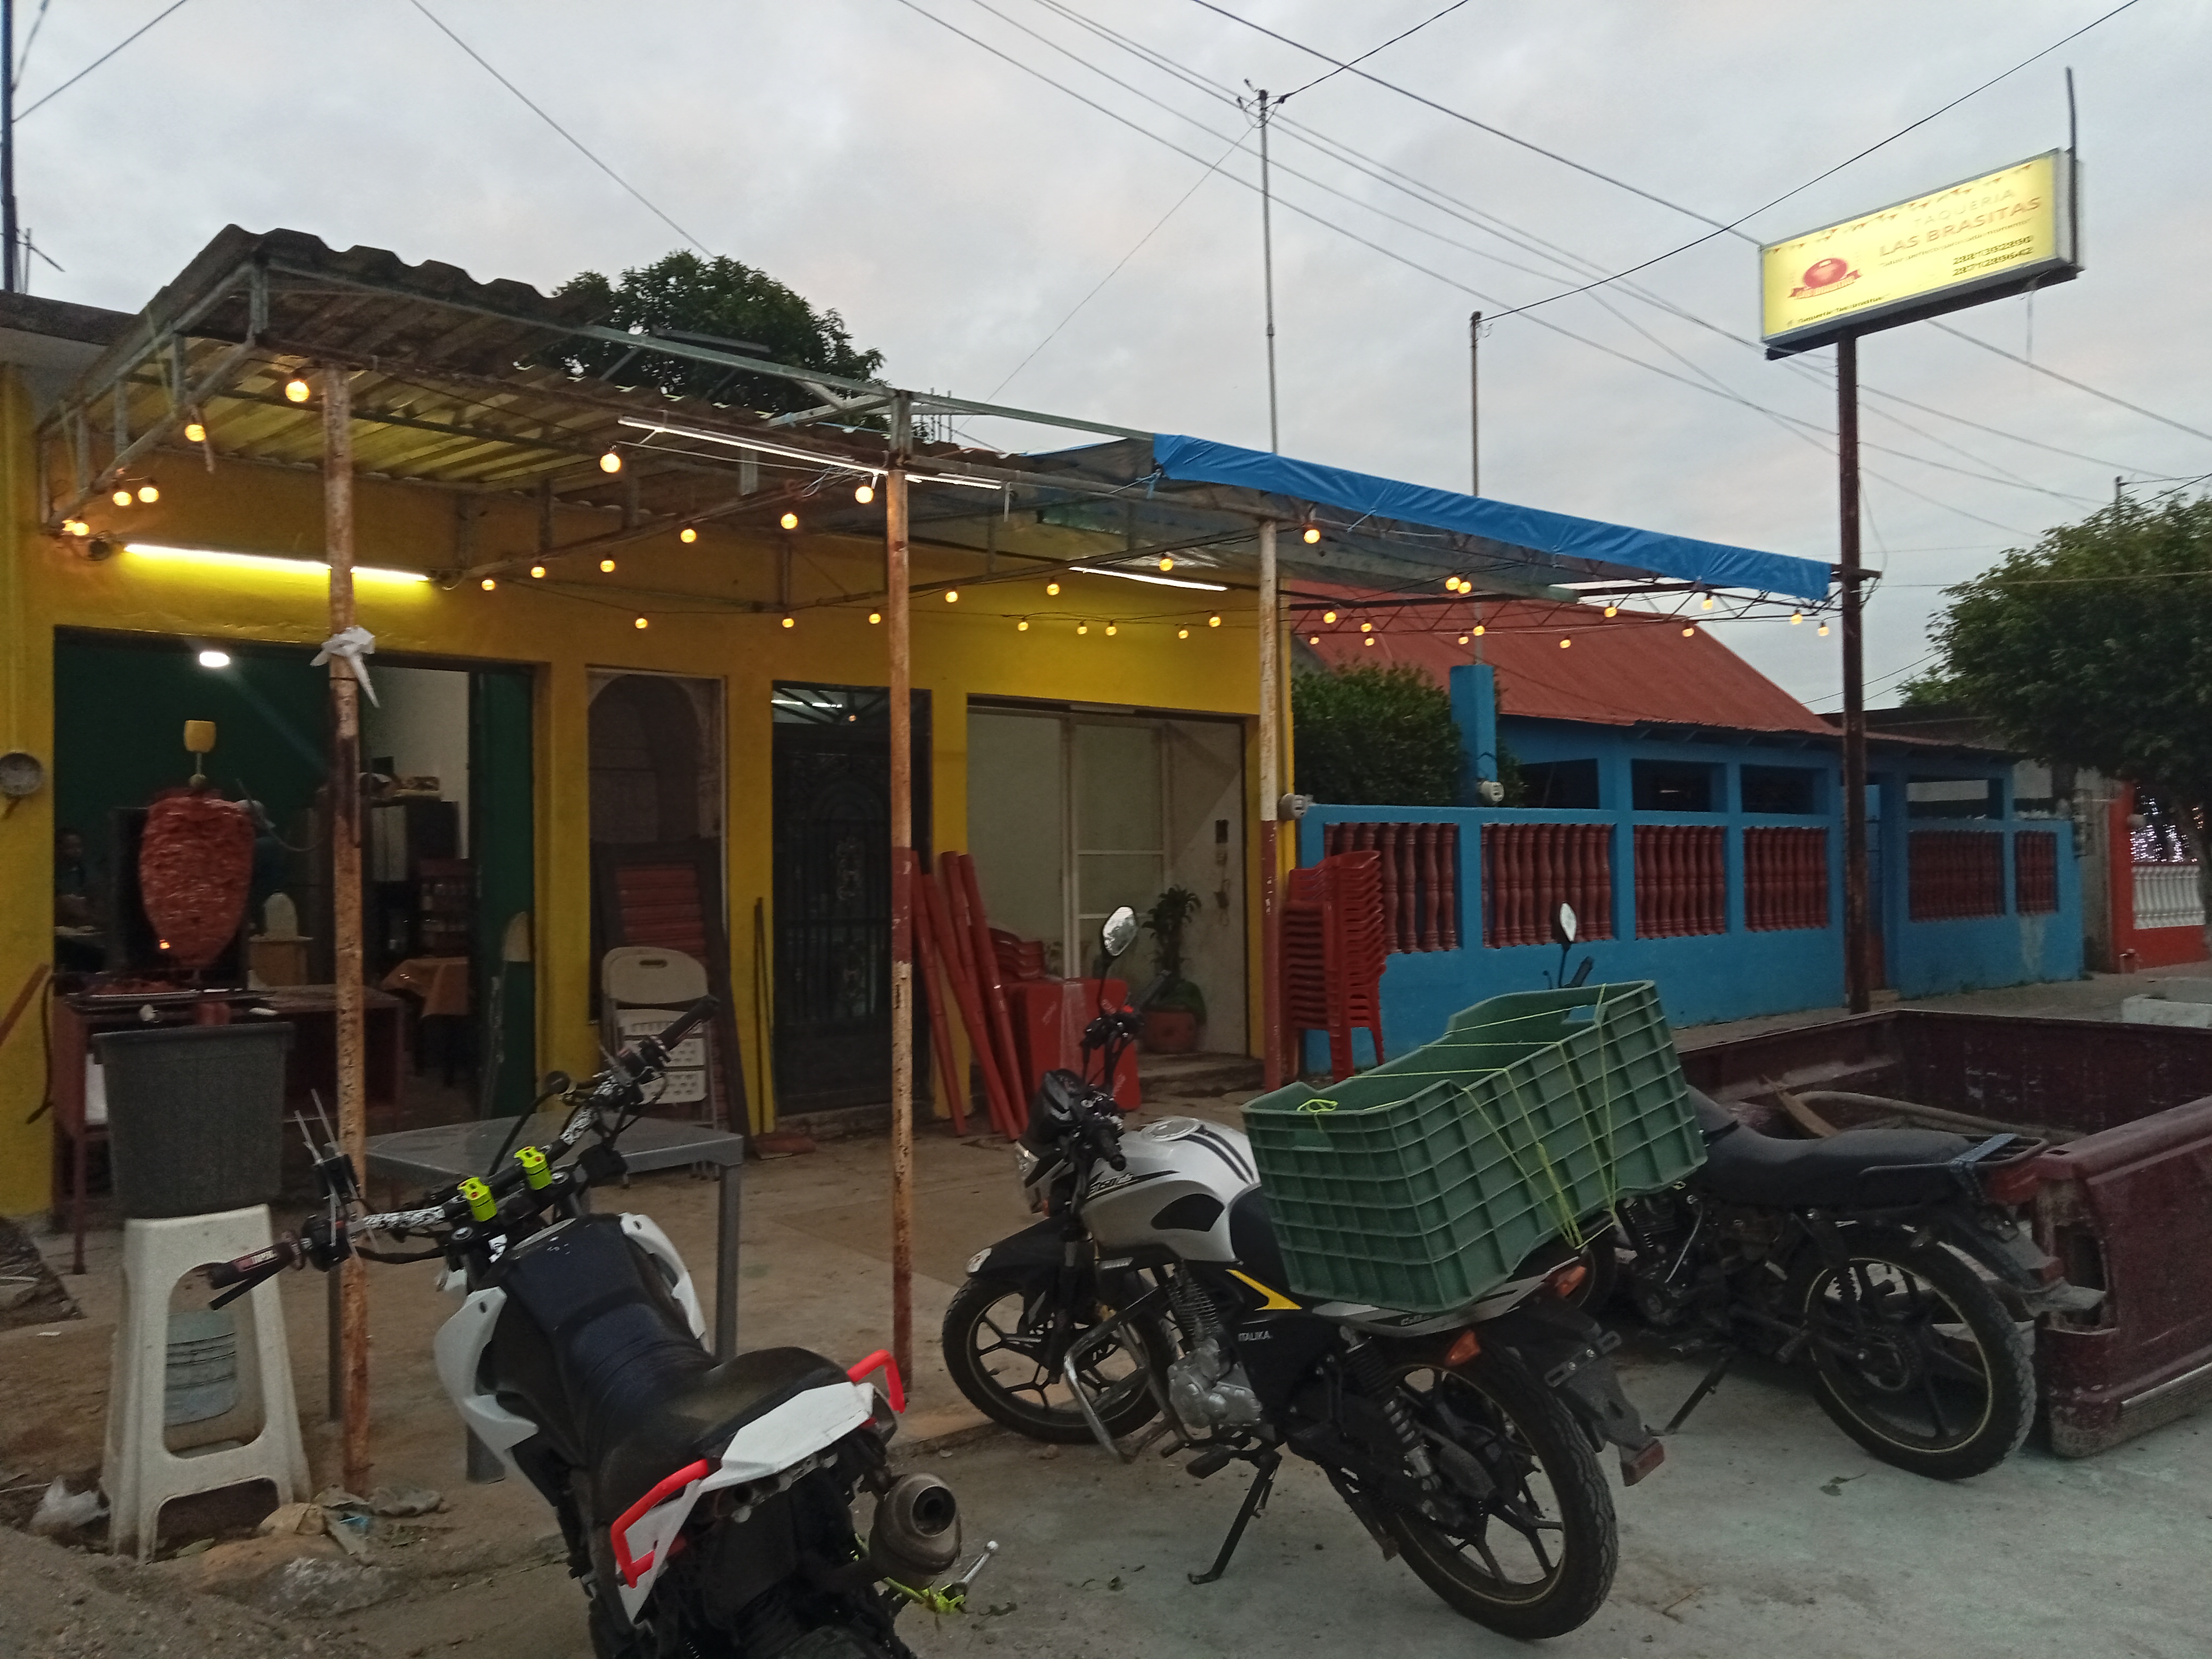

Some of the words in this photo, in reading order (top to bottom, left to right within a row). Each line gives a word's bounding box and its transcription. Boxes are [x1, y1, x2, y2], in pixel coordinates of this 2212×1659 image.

[1879, 235, 1921, 257] LAS
[1925, 196, 2042, 243] BRASITAS
[1914, 189, 2016, 228] TAQUERIA
